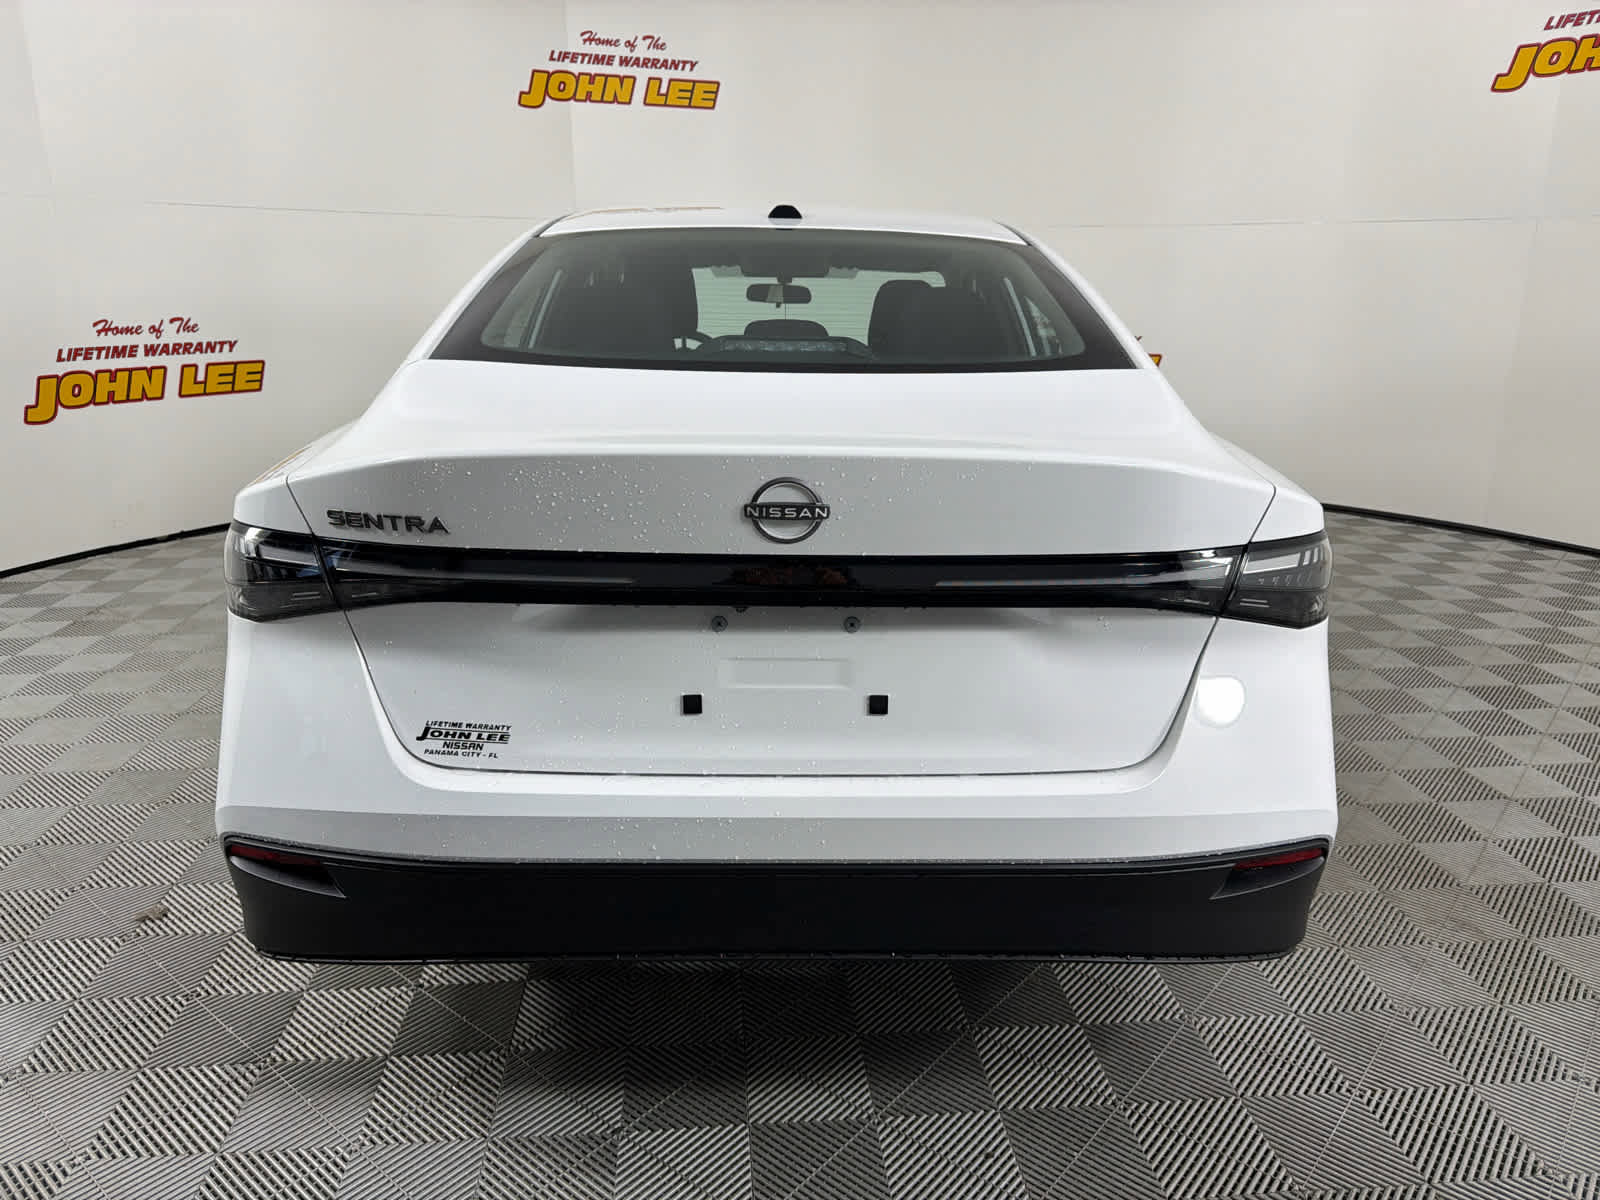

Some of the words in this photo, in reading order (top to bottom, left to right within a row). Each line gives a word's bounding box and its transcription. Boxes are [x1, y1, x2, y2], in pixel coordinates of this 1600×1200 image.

[580, 30, 620, 47] Home
[624, 36, 638, 52] of
[642, 35, 667, 51] The
[549, 49, 615, 66] LIFETIME
[619, 55, 698, 72] WARRANTY
[518, 69, 636, 109] JOHN
[643, 77, 720, 110] LEE
[92, 319, 143, 337] Home
[148, 319, 163, 339] of
[169, 317, 199, 334] The
[56, 344, 139, 362] LIFETIME
[144, 340, 238, 357] WARRANTY
[24, 365, 167, 425] JOHN
[178, 360, 265, 398] LEE
[326, 510, 450, 534] SENTRA
[746, 507, 828, 518] NISSAN
[416, 727, 472, 741] JOHN
[475, 732, 511, 742] LEE
[425, 720, 463, 729] LIFETIME
[465, 723, 512, 731] WARRANTY
[424, 749, 459, 757] PANAMA
[442, 741, 484, 751] NISSAN
